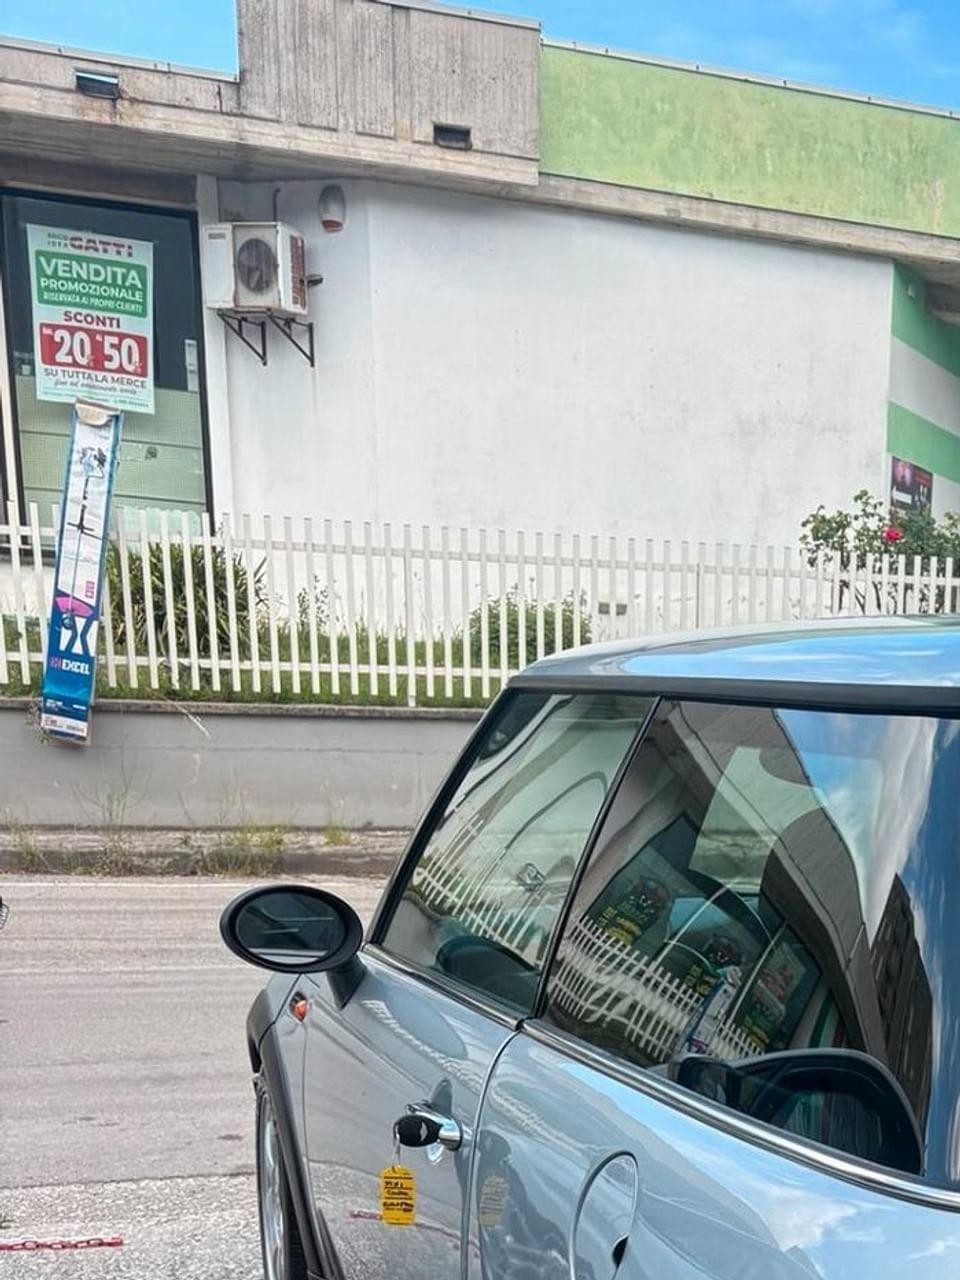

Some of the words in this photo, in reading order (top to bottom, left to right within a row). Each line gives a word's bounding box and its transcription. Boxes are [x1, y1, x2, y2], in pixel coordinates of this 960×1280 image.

[39, 256, 142, 288] VENDITA
[41, 278, 143, 302] PROMOZIONALE
[63, 310, 120, 328] SCONTI
[43, 367, 58, 376] SU
[61, 369, 93, 382] TUTTA
[94, 374, 108, 384] LA
[111, 376, 147, 389] MERCE
[62, 659, 90, 675] EXCEL
